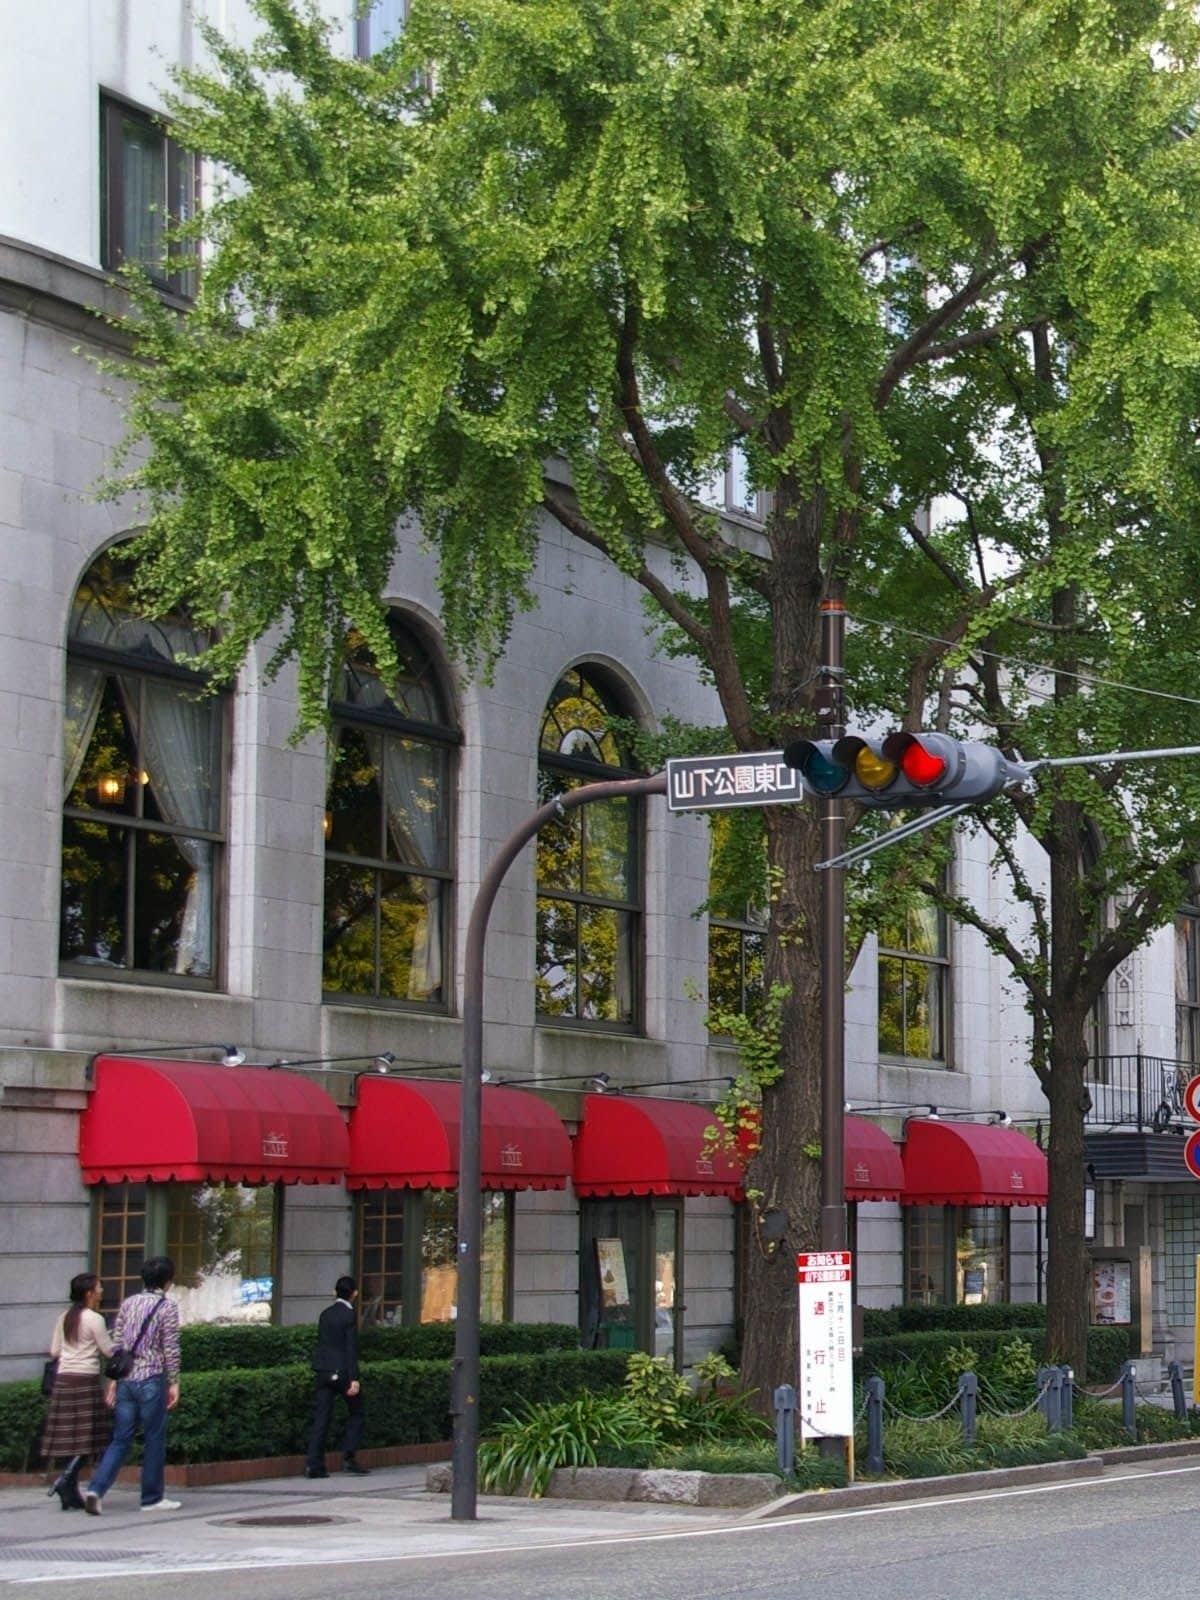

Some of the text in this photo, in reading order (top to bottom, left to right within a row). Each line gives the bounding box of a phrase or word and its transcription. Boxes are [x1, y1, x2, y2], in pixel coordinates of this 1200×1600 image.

[675, 764, 795, 798] 山下公園東口
[807, 1254, 843, 1266] お知らせ
[814, 1301, 826, 1413] 通行止
